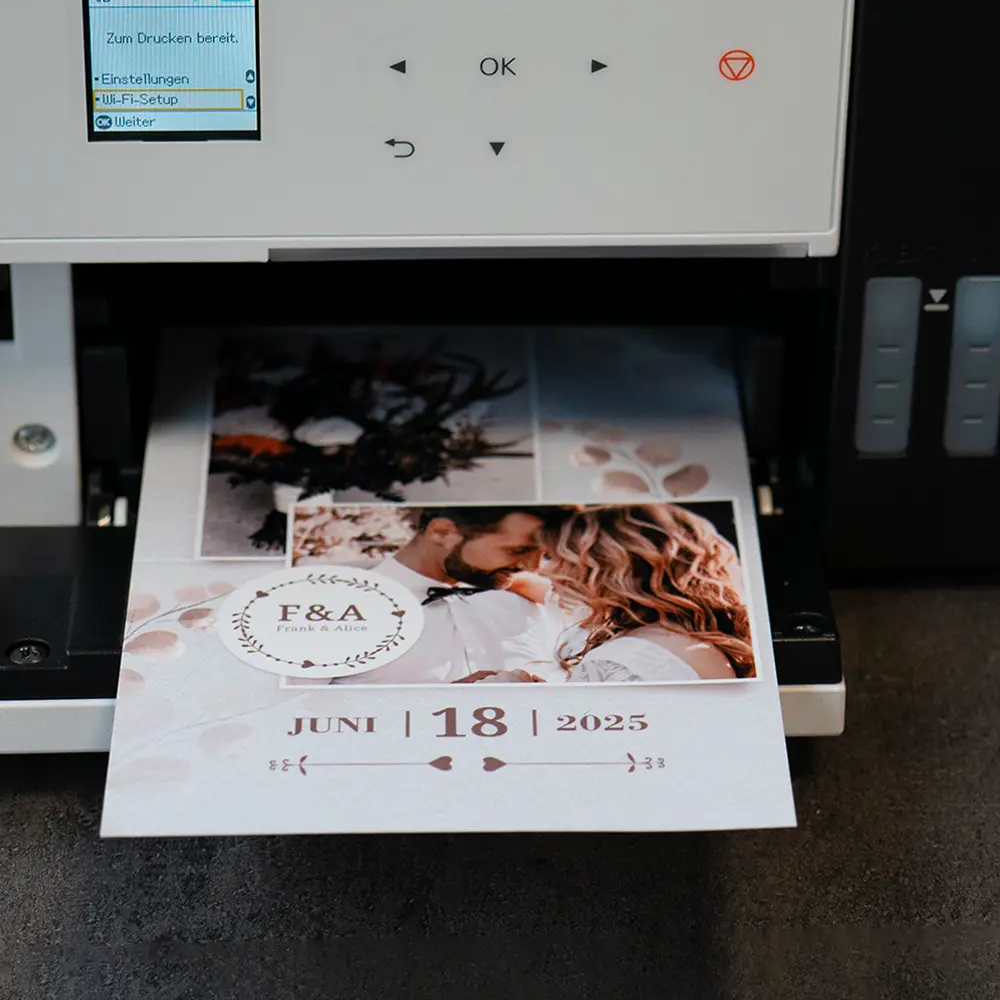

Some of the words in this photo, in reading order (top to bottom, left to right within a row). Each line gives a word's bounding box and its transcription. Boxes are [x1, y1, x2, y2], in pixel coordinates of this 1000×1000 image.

[106, 32, 133, 44] Zum
[137, 32, 192, 44] Drucken
[196, 32, 239, 44] bereit.
[479, 57, 516, 76] OK
[102, 73, 190, 86] Einstellungen
[102, 93, 179, 107] Wi-Fi-Setup
[97, 117, 112, 128] OK
[114, 116, 156, 128] Weiter
[278, 604, 367, 622] F&A
[287, 716, 378, 737] JUNI
[431, 706, 508, 738] 18
[556, 714, 649, 732] 2025
